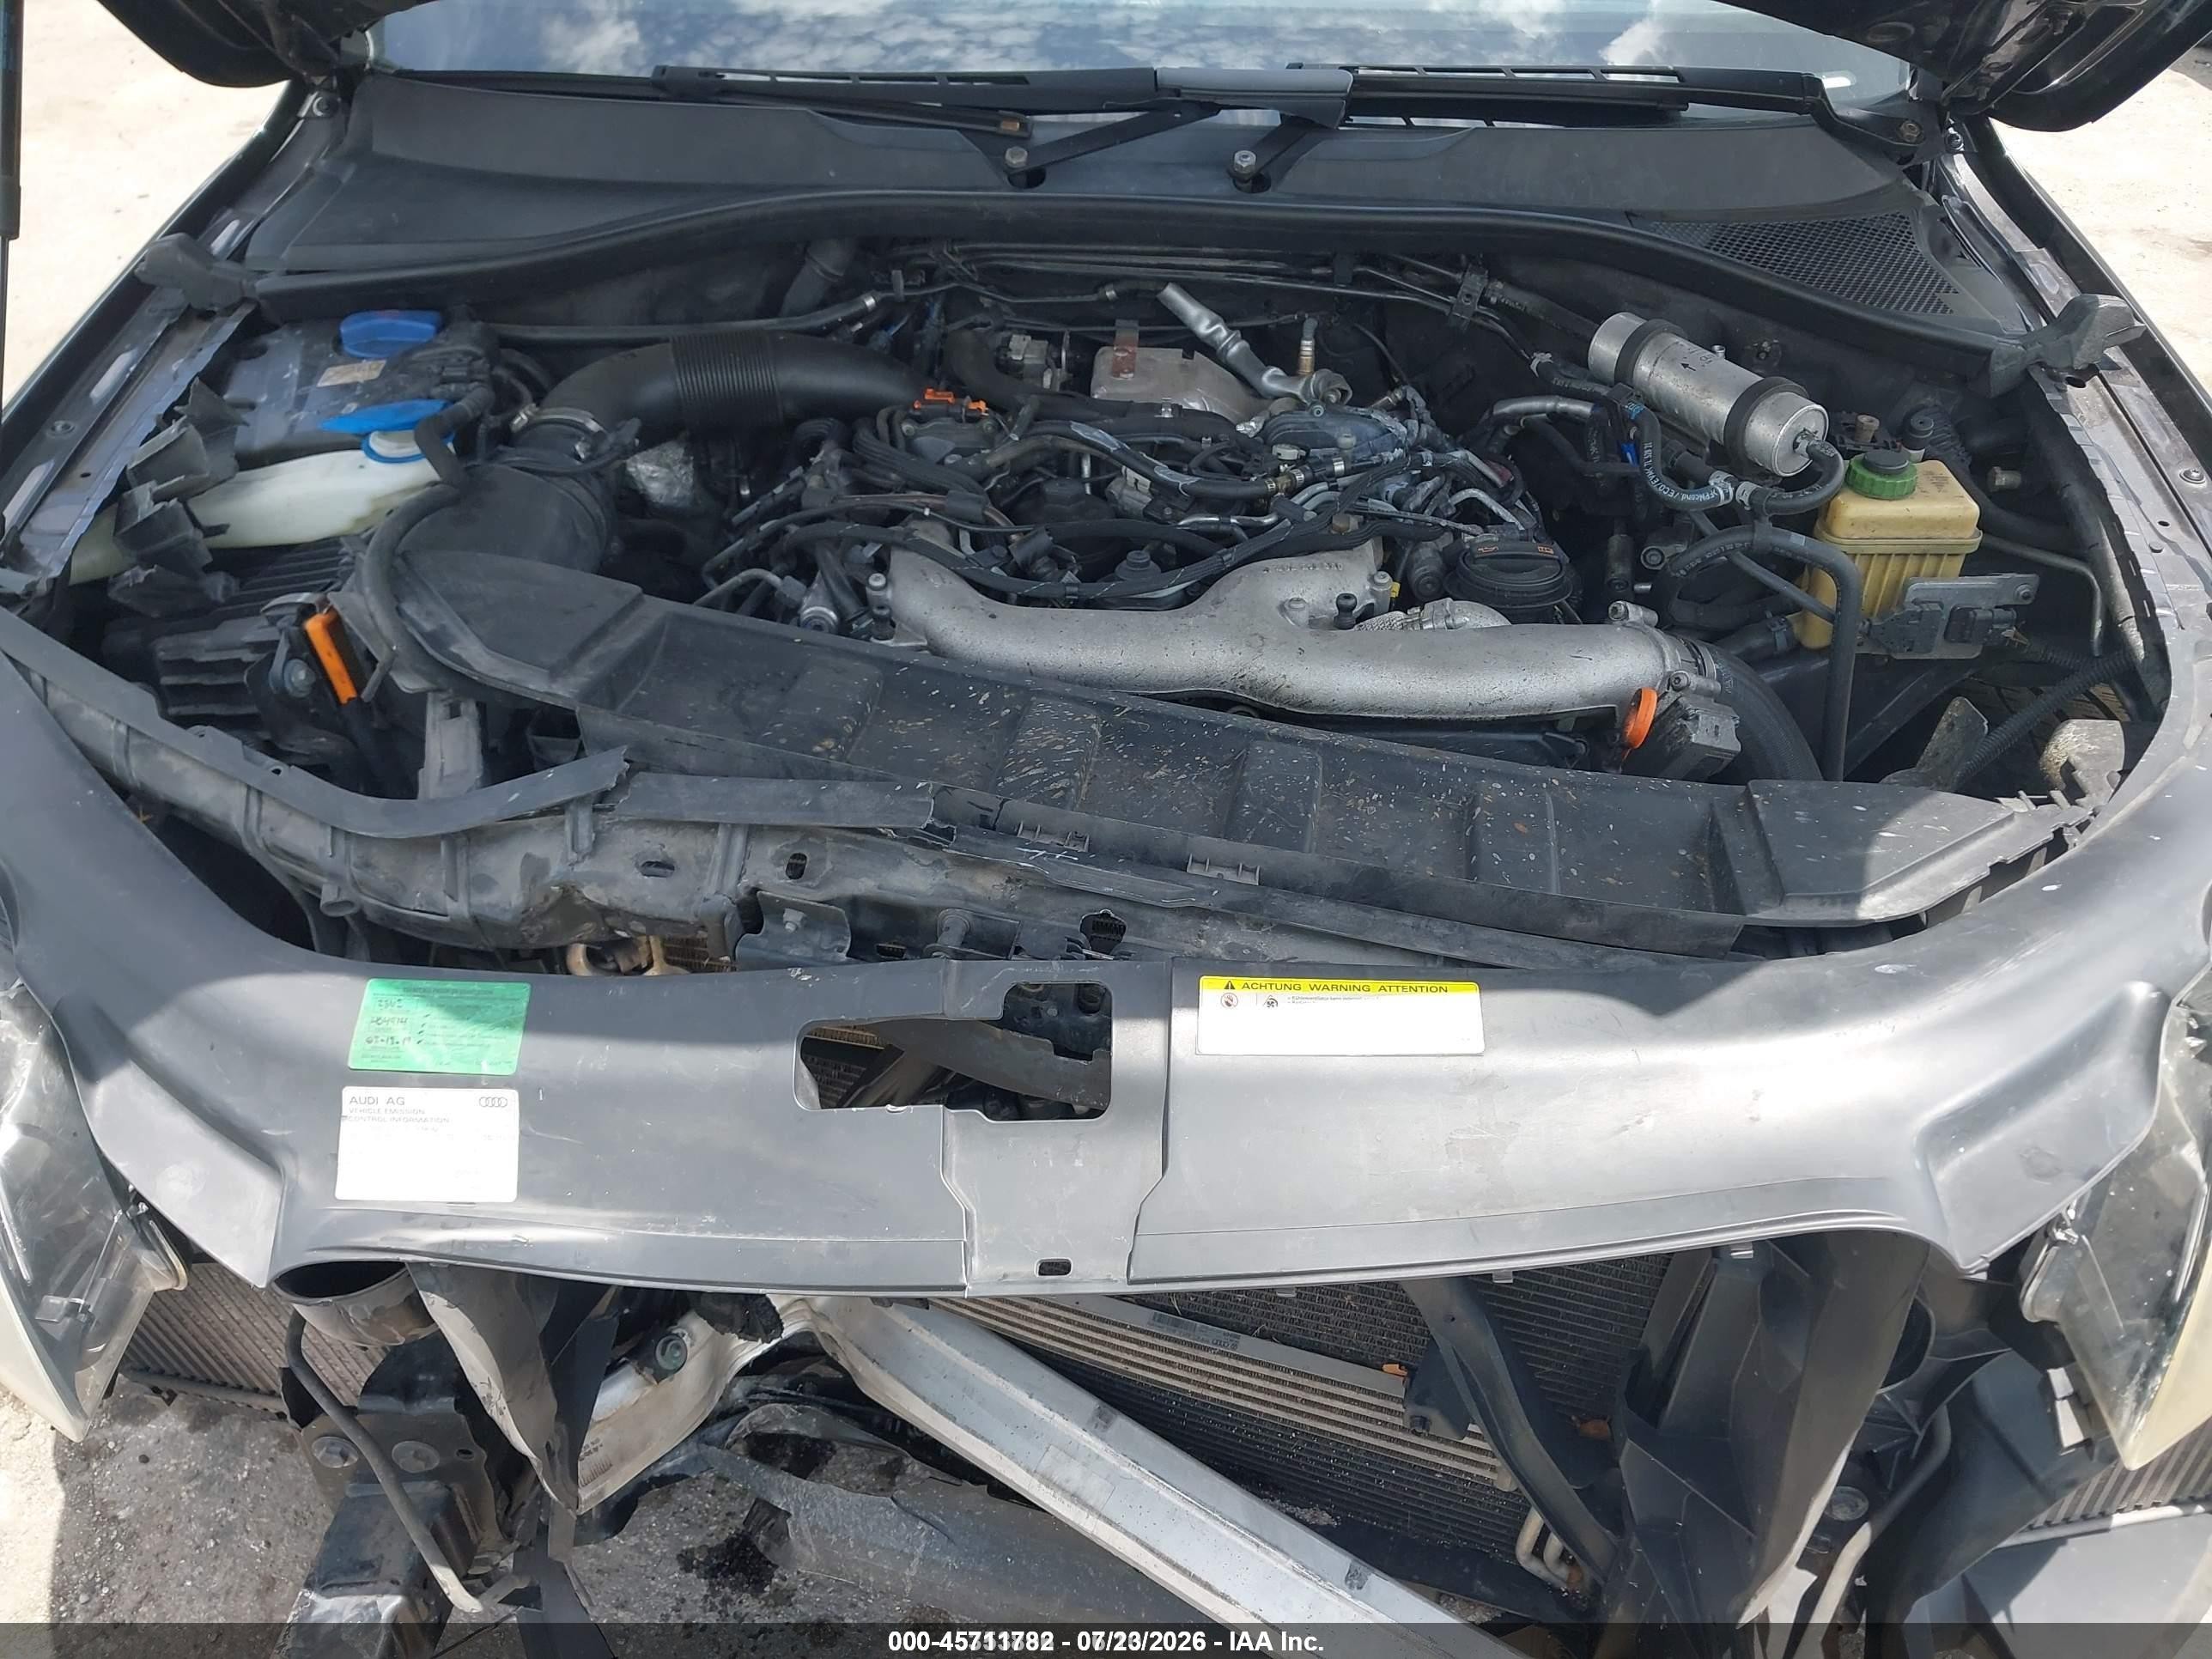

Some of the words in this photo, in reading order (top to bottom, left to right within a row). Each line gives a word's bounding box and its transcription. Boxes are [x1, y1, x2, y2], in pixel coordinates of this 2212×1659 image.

[1241, 981, 1302, 991] ACHTUNG
[1308, 983, 1371, 993] WARNING
[1377, 985, 1449, 994] ATTENTION
[349, 1096, 379, 1105] AUDI
[386, 1097, 405, 1106] AG
